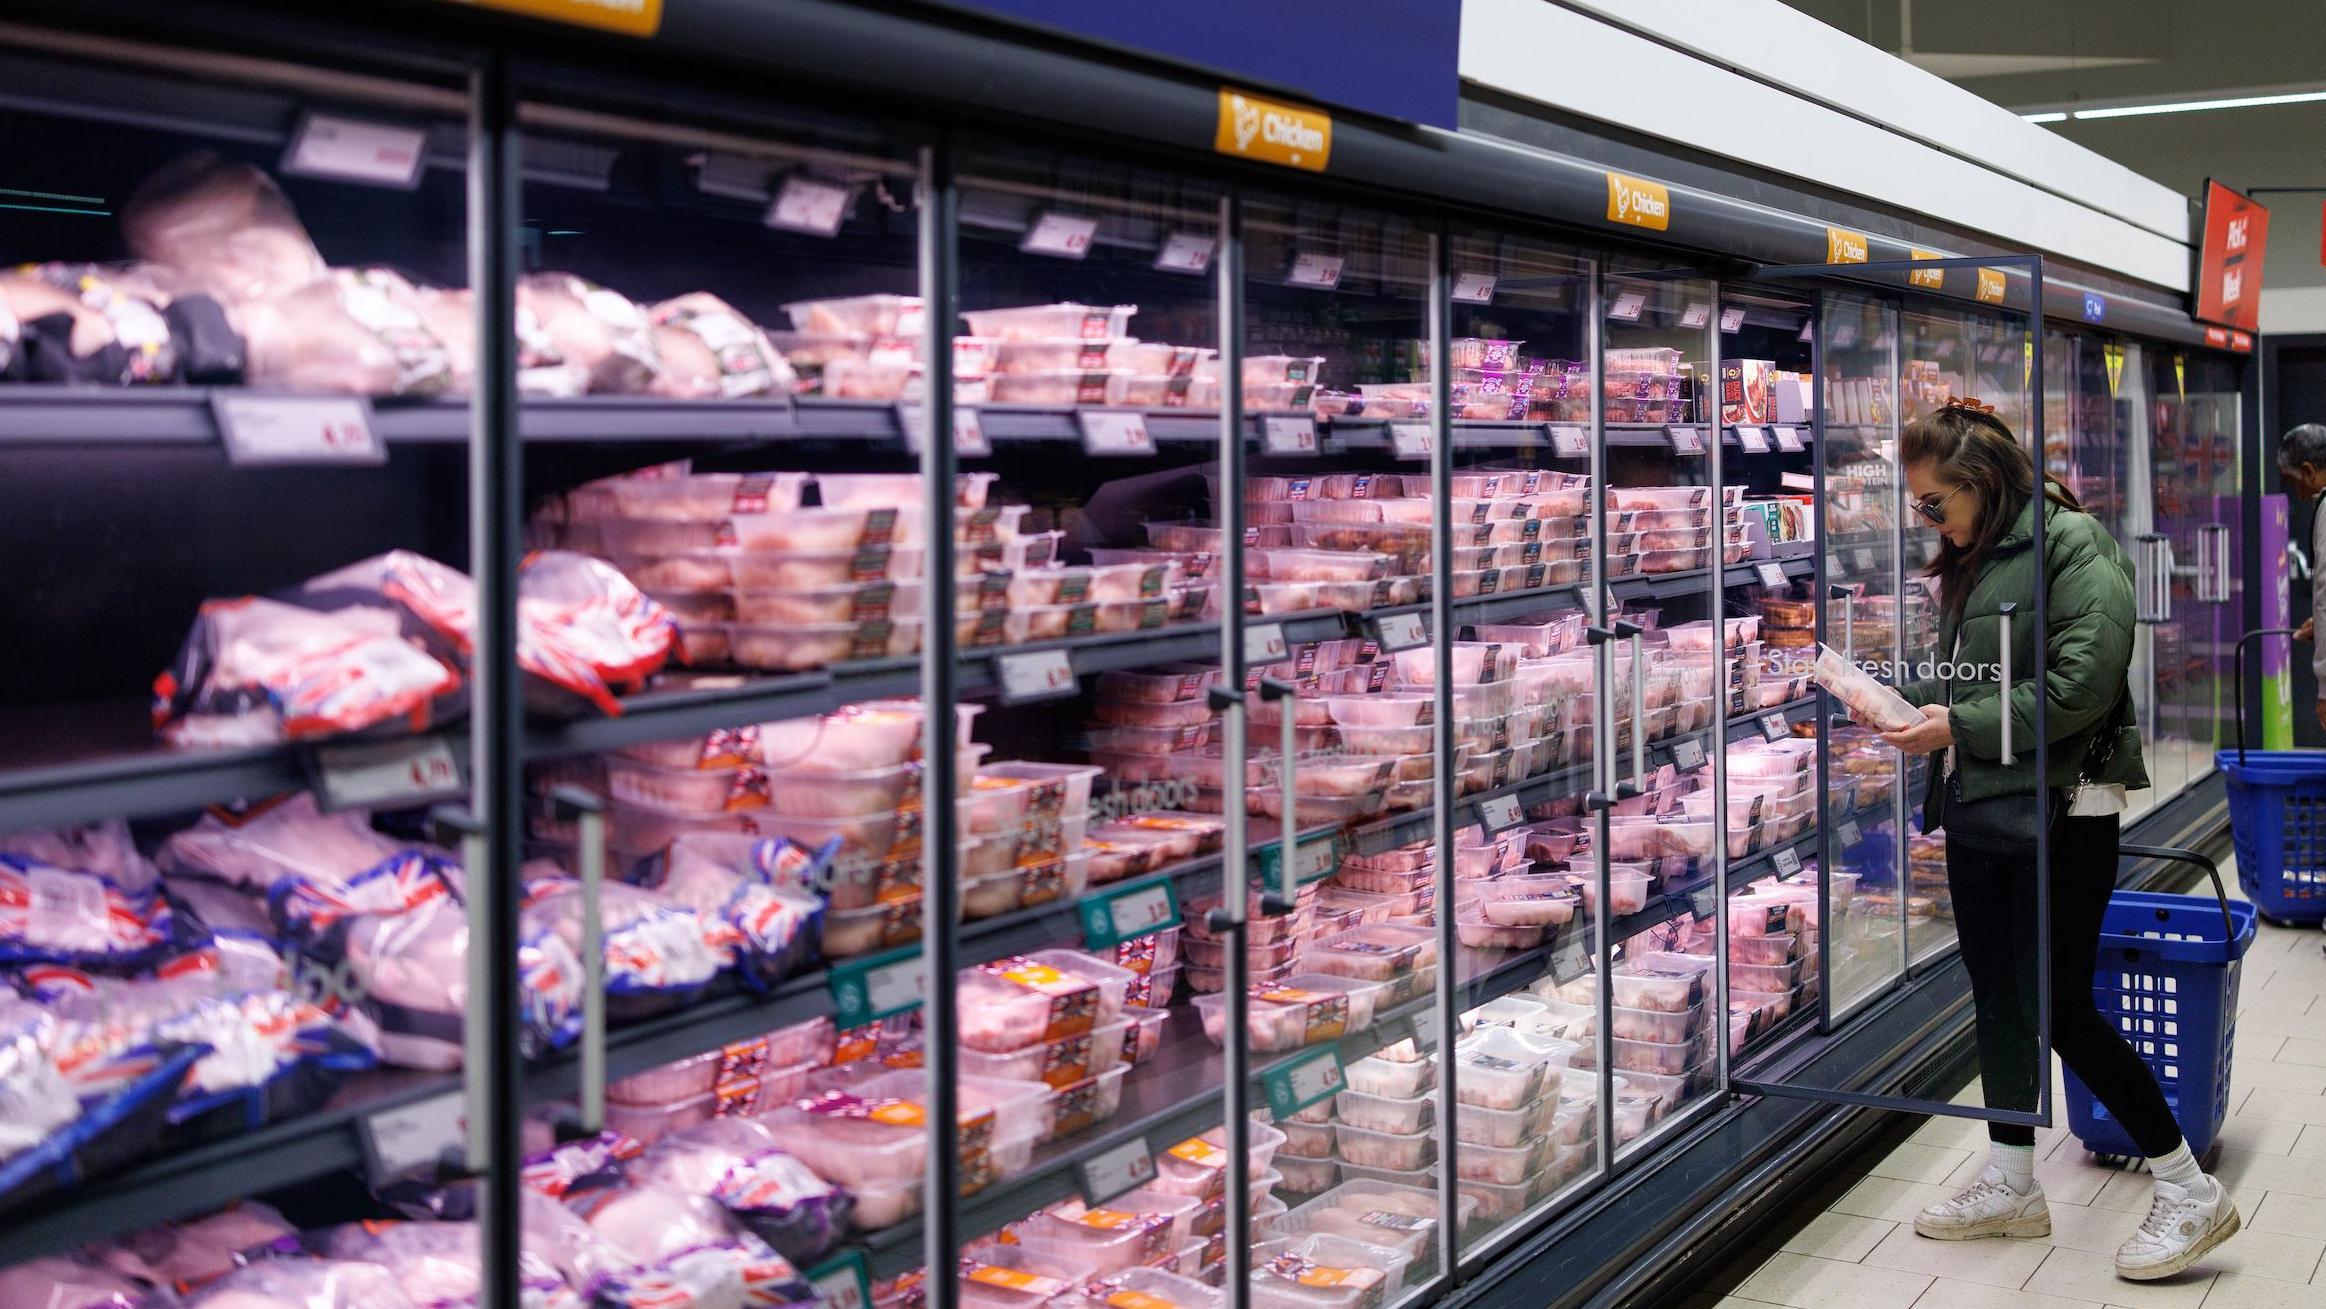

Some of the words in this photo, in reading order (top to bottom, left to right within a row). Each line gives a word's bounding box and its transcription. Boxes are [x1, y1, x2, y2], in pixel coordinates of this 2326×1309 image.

[1262, 111, 1323, 152] Chicken
[1632, 190, 1664, 217] Chicken
[1843, 240, 1864, 259] Chicken
[1988, 281, 2004, 297] Chicken
[1846, 464, 1887, 477] HIGH
[1916, 651, 2001, 682] doors
